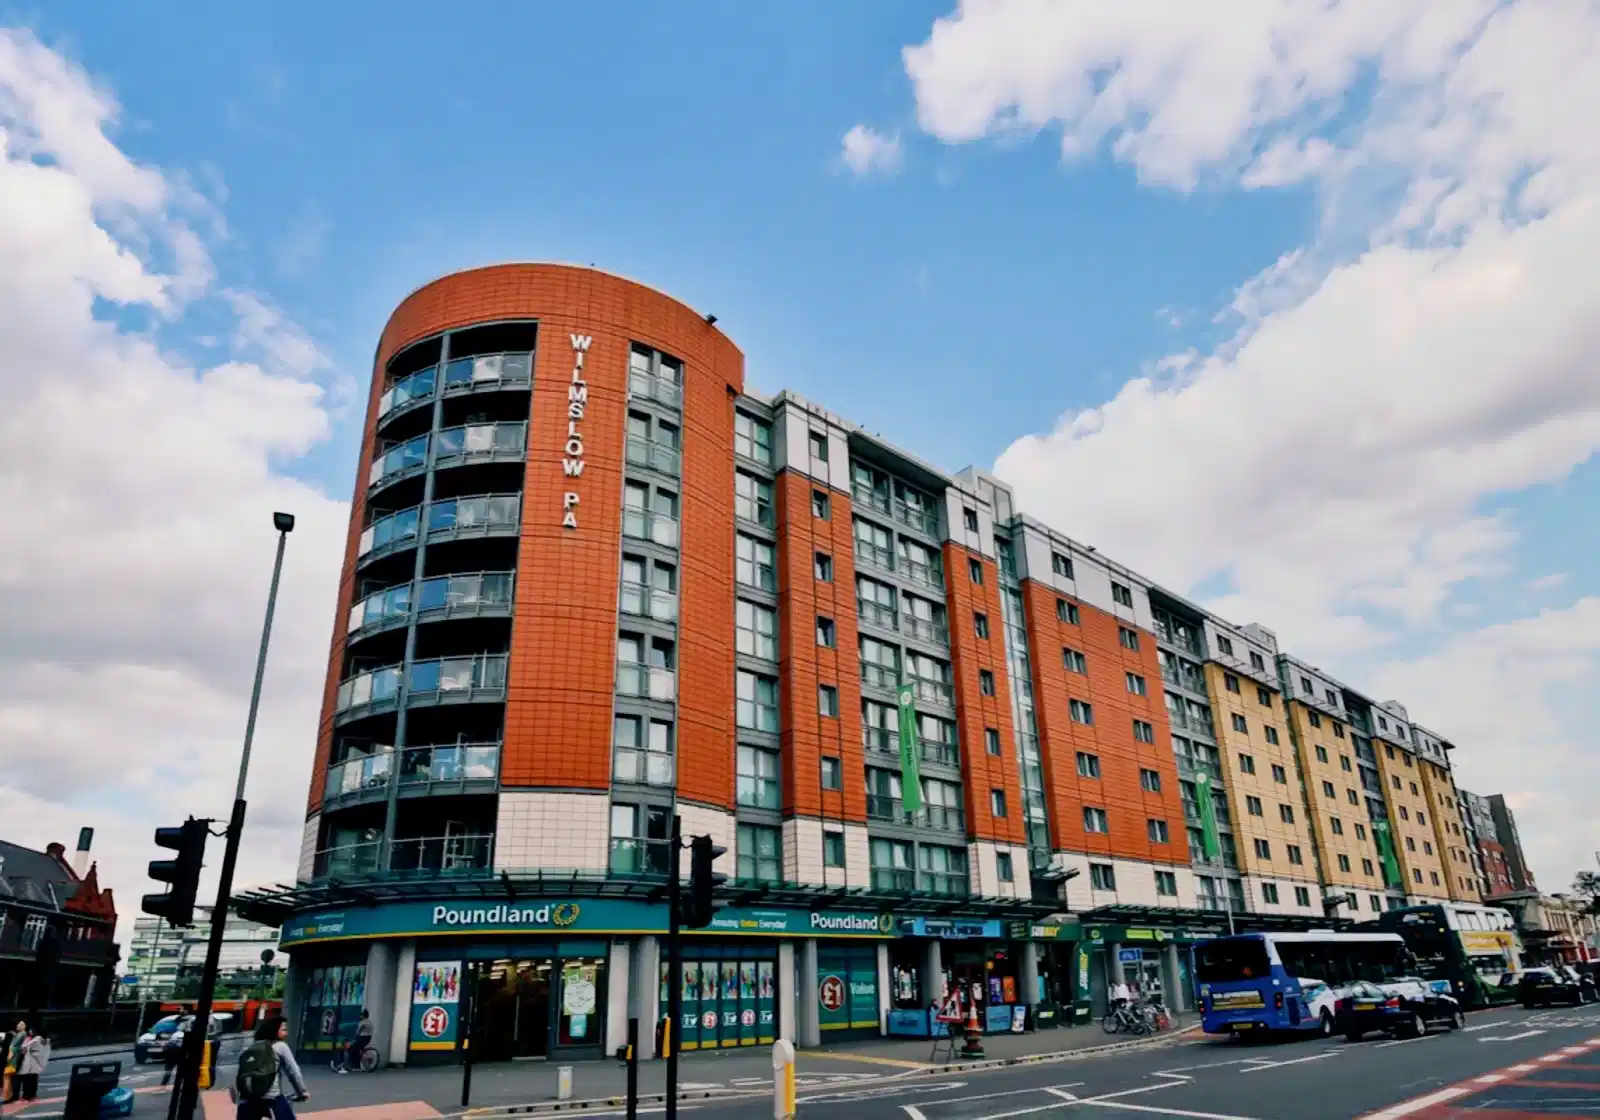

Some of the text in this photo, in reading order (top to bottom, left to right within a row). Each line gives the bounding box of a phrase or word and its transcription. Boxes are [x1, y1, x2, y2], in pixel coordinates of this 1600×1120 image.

[561, 334, 593, 529] WILMSLOW PA
[432, 903, 550, 925] Poundland
[810, 912, 879, 931] Poundland
[823, 982, 842, 1006] £1
[425, 1013, 445, 1033] £1
